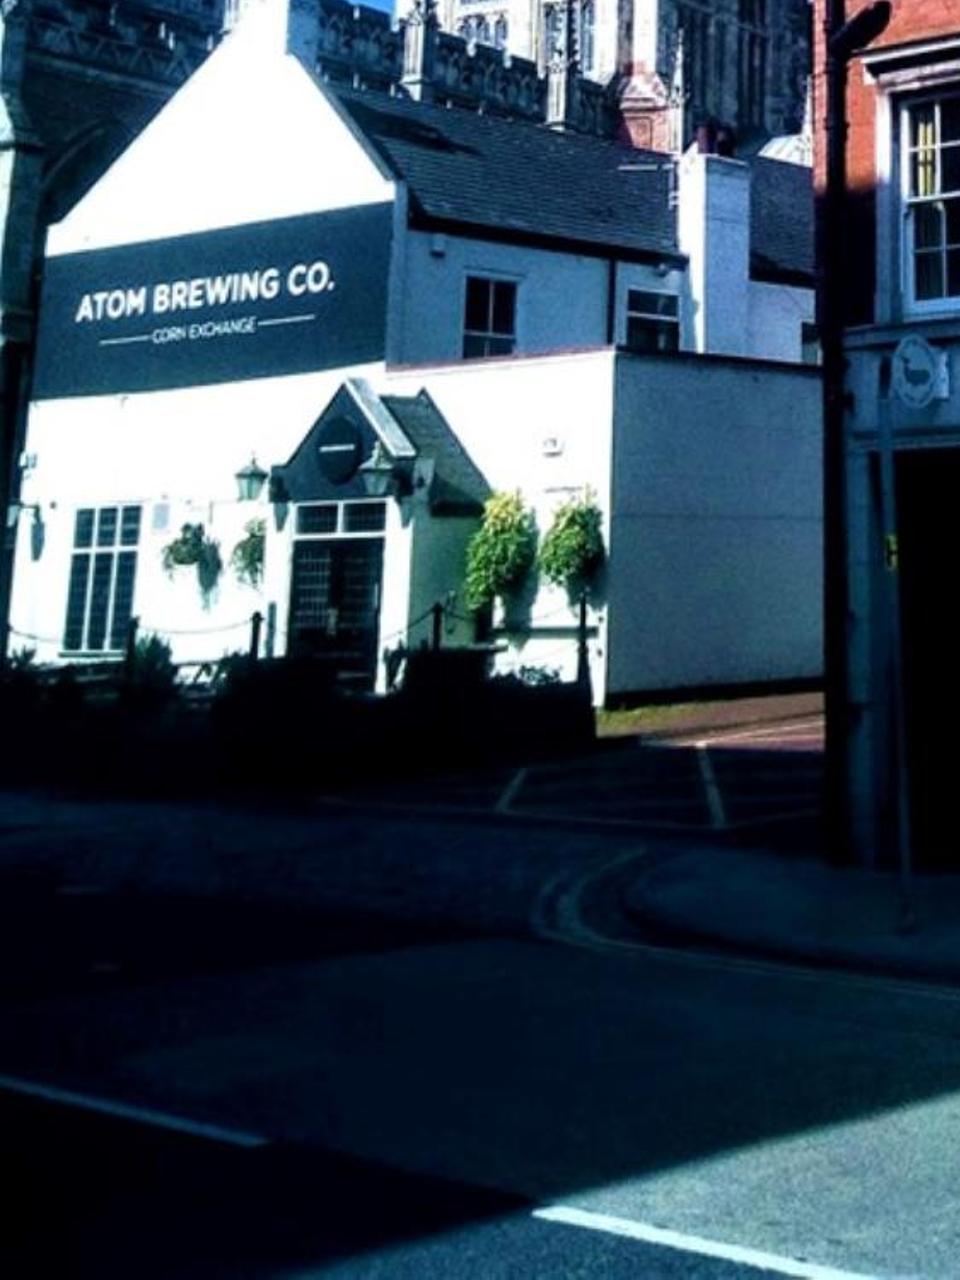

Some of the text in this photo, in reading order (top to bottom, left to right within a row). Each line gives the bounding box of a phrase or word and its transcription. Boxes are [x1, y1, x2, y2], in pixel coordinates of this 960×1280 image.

[75, 261, 336, 323] ATOM BREWING CO.
[152, 316, 257, 345] CORN EXCHANGE
